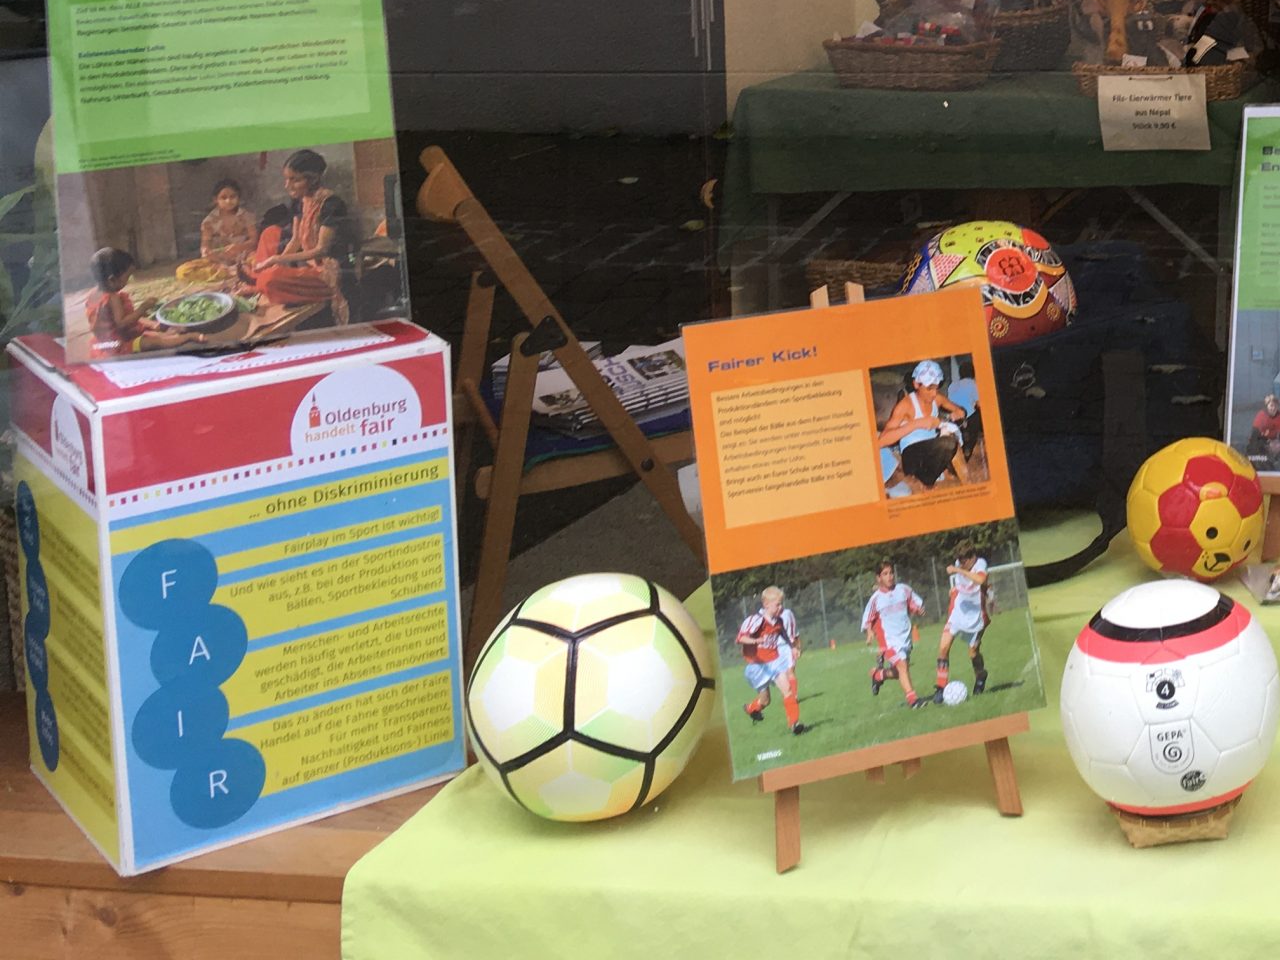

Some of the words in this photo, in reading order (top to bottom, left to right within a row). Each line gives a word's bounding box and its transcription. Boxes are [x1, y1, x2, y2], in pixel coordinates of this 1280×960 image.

[708, 356, 765, 373] Fairer
[772, 346, 817, 363] Kick!
[304, 424, 356, 444] handelt
[360, 416, 396, 435] fair
[325, 396, 407, 424] Oldenburg
[266, 495, 307, 514] ohne
[313, 465, 439, 503] Diskriminierung
[284, 534, 328, 554] Fairplay
[332, 532, 346, 543] im
[350, 523, 379, 540] Sport
[382, 520, 395, 531] ist
[398, 509, 440, 527] wichtig!
[161, 569, 177, 598] F
[230, 583, 253, 598] Und
[257, 578, 277, 592] wie
[279, 570, 308, 585] sieht
[311, 567, 323, 577] es
[327, 562, 338, 573] in
[341, 558, 359, 570] der
[363, 539, 440, 566] Sportindustrie
[268, 591, 291, 602] aus,
[316, 577, 333, 591] bei
[337, 573, 355, 585] der
[359, 557, 419, 579] Produktion
[422, 553, 441, 564] von
[287, 596, 324, 612] Bällen,
[328, 572, 418, 602] Sportbekleidung
[421, 565, 442, 578] und
[390, 579, 443, 600] Schuhen?
[188, 636, 210, 665] A
[255, 660, 297, 678] werden
[301, 648, 336, 666] häufig
[338, 638, 380, 655] verletzt,
[385, 632, 401, 643] die
[405, 620, 445, 639] Umwelt
[283, 635, 344, 656] Menschen-
[348, 627, 369, 639] und
[373, 606, 444, 632] Arbeitsrechte
[260, 669, 323, 693] geschädigt,
[327, 659, 344, 673] die
[348, 641, 422, 667] Arbeiterinnen
[425, 633, 446, 647] und
[274, 681, 319, 702] Arbeiter
[323, 675, 340, 687] ins
[343, 664, 382, 683] Abseits
[386, 648, 446, 670] manövriert.
[273, 718, 293, 732] Das
[297, 714, 310, 725] zu
[313, 702, 352, 718] ändern
[355, 696, 374, 708] hat
[376, 689, 398, 703] sich
[401, 682, 419, 696] der
[422, 675, 449, 690] Faire
[1161, 683, 1170, 696] 4
[260, 730, 300, 750] Handel
[304, 723, 321, 737] auf
[325, 715, 343, 731] die
[346, 707, 379, 725] Fahne
[301, 735, 379, 766] Nachhaltigkeit
[383, 728, 403, 742] und
[407, 716, 451, 733] Fairness
[330, 732, 346, 743] Für
[351, 723, 379, 736] mehr
[383, 703, 451, 728] Transparenz,
[1157, 729, 1183, 742] GEPA
[282, 771, 300, 786] auf
[303, 761, 340, 781] ganzer
[424, 728, 449, 744] Linie
[209, 769, 228, 798] R
